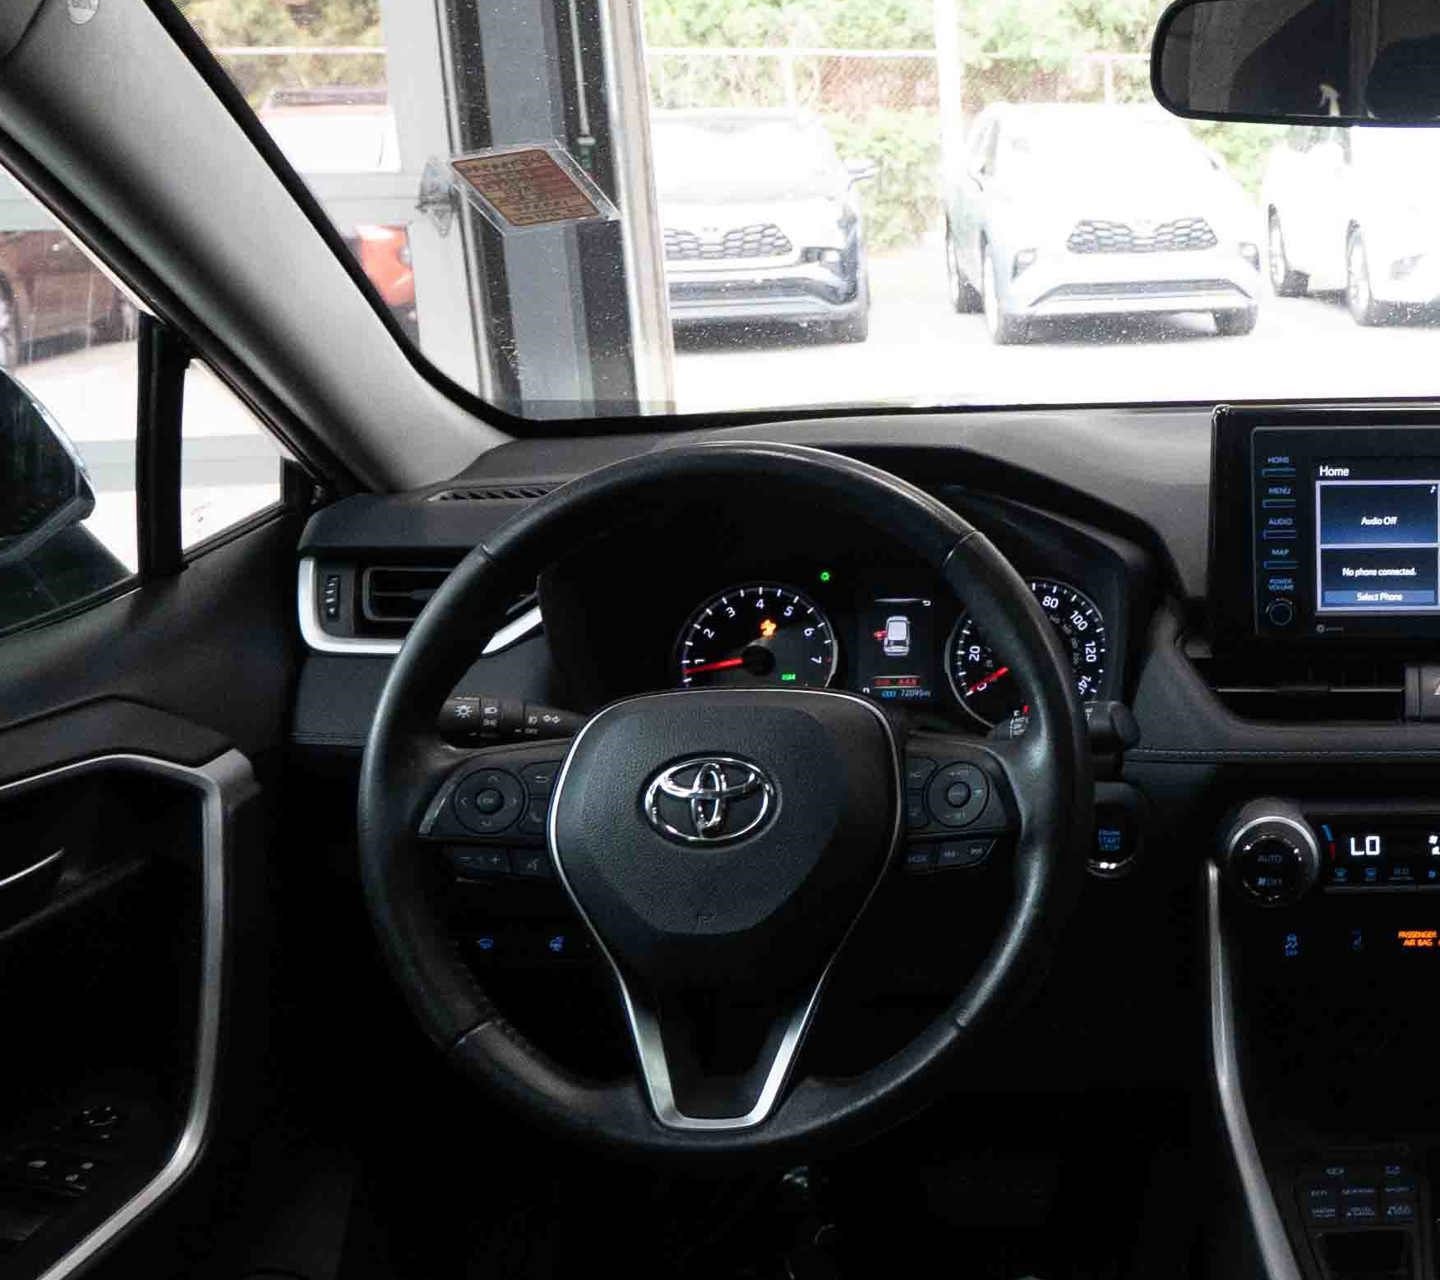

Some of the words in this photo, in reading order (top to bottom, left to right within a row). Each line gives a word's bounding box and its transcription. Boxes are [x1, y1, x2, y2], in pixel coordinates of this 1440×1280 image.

[1319, 465, 1350, 477] Home
[1268, 487, 1292, 495] MENU
[1268, 518, 1293, 526] AUDIO
[1360, 516, 1383, 526] Audio
[1383, 516, 1399, 526] Off
[1271, 549, 1290, 557] MAP
[1342, 568, 1354, 576] No
[1355, 568, 1377, 578] phone
[1356, 592, 1378, 601] Select
[1380, 592, 1403, 601] Phone
[756, 599, 764, 609] 4
[1042, 595, 1059, 609] 80
[725, 606, 736, 618] 3
[783, 605, 794, 617] 5
[1069, 610, 1088, 632] 100
[702, 628, 715, 639] 2
[803, 627, 815, 637] 6
[968, 645, 981, 662] 20
[1085, 641, 1097, 663] 120
[694, 657, 705, 665] 1
[810, 655, 822, 665] 7
[1350, 835, 1381, 856] LO
